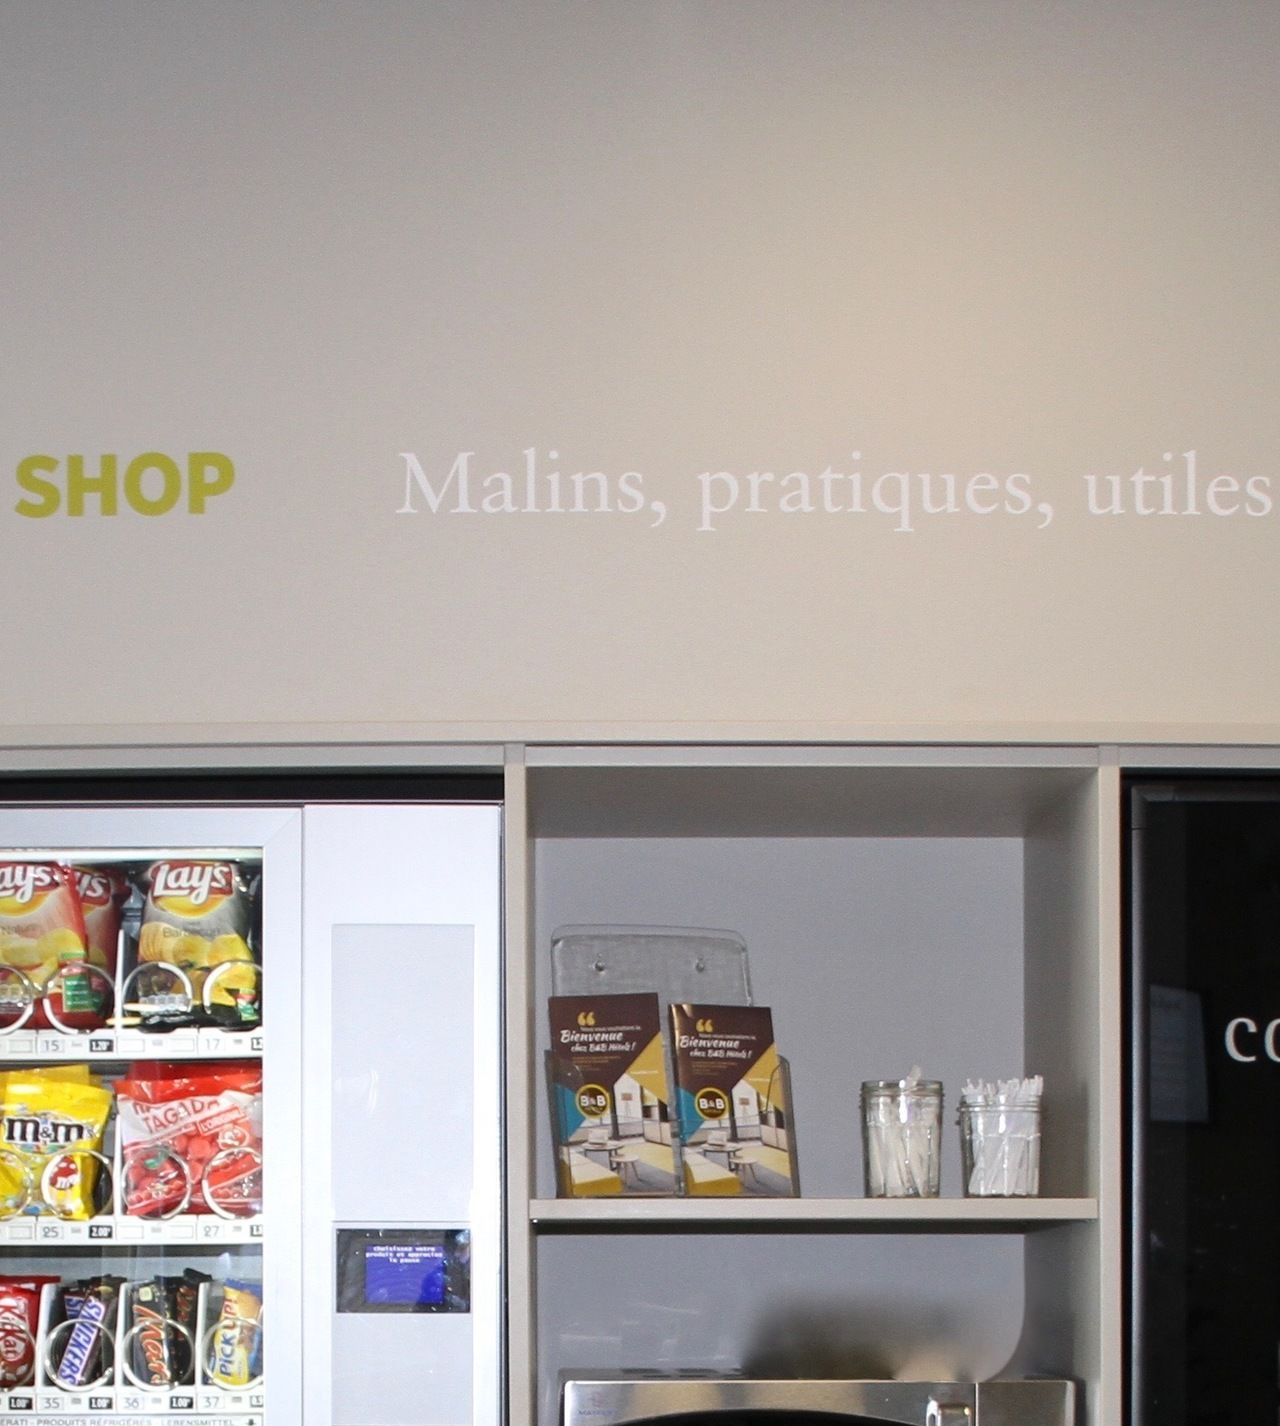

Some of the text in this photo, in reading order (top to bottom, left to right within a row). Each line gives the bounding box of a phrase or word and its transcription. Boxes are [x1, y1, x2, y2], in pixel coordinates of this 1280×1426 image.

[13, 450, 236, 517] SHOP
[396, 448, 668, 528] Malins,
[695, 450, 1054, 532] pratiques,
[1083, 450, 1274, 518] utiles
[560, 1029, 624, 1043] Bienvenue
[679, 1035, 740, 1048] Bienvenue
[43, 1039, 60, 1051] 15
[205, 1038, 221, 1050] 17
[42, 1227, 59, 1239] 25
[204, 1226, 220, 1238] 27
[57, 1296, 106, 1386] SNICKERS
[43, 1398, 61, 1409] 35
[123, 1397, 140, 1410] 36
[203, 1396, 219, 1408] 37
[36, 1417, 88, 1426] PRODUITS
[160, 1416, 235, 1426] LEBENSMITTEL
